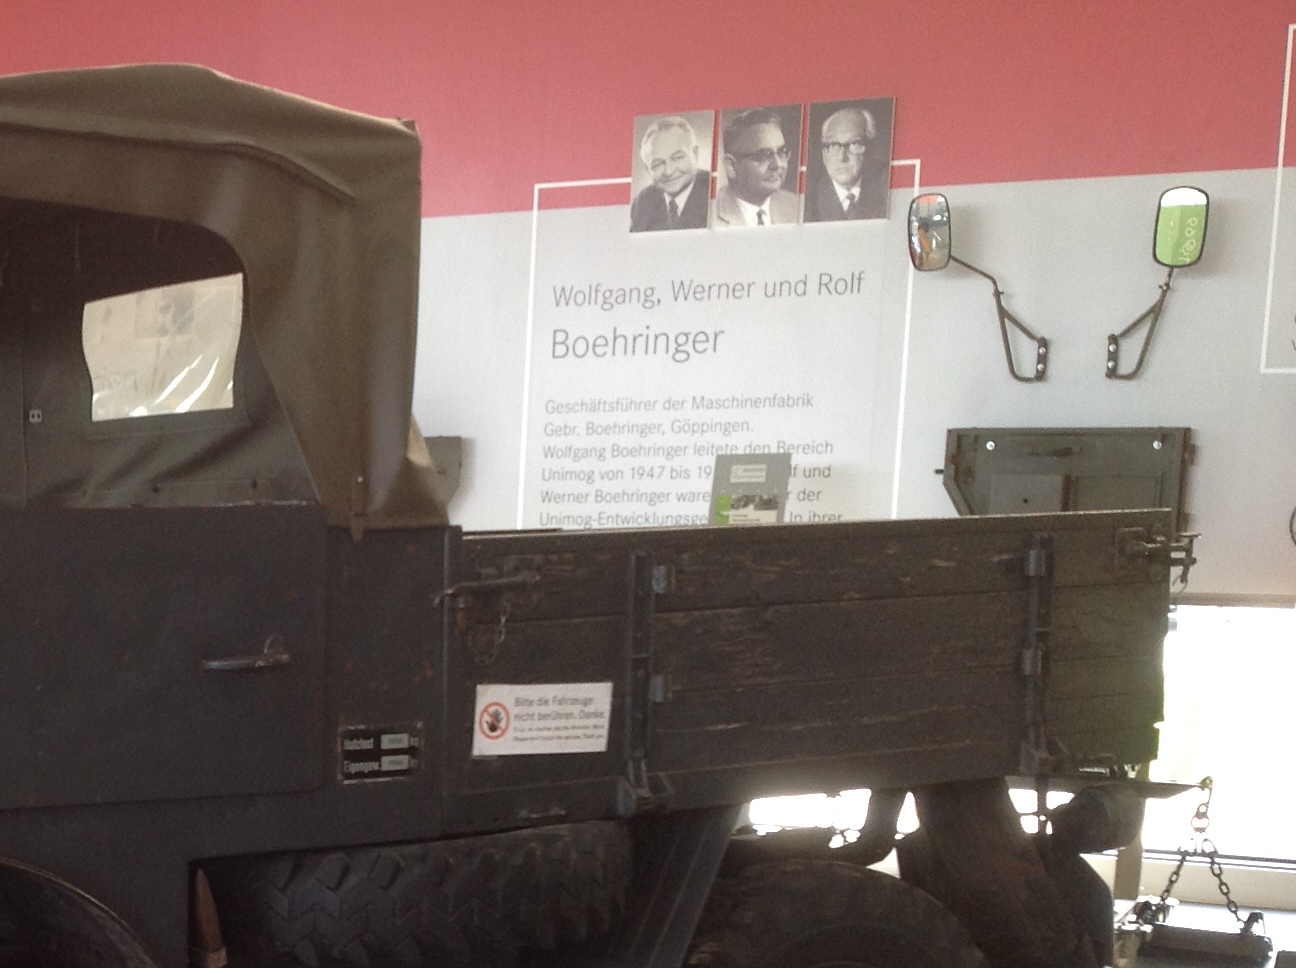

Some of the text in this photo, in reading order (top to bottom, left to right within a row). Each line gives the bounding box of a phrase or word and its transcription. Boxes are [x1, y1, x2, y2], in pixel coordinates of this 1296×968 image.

[553, 271, 865, 311] Wolfgang, Werner und Rolf
[551, 325, 724, 363] Boehringer
[545, 393, 813, 415] Geschäftsführer der Maschinenfabrik
[544, 419, 754, 440] Gebr. Boehringer, Göppingen.
[543, 440, 834, 462] Wolfgang Boehringer leitete den Bereich
[541, 467, 594, 485] Unimog
[598, 470, 623, 482] von
[630, 466, 665, 481] 1947
[670, 465, 690, 480] bis
[697, 465, 712, 479] 19
[803, 464, 831, 479] und
[540, 487, 822, 507] Werner Boehringer ware der
[539, 511, 708, 528] Unimog-Entwicklungsge
[790, 511, 802, 524] In
